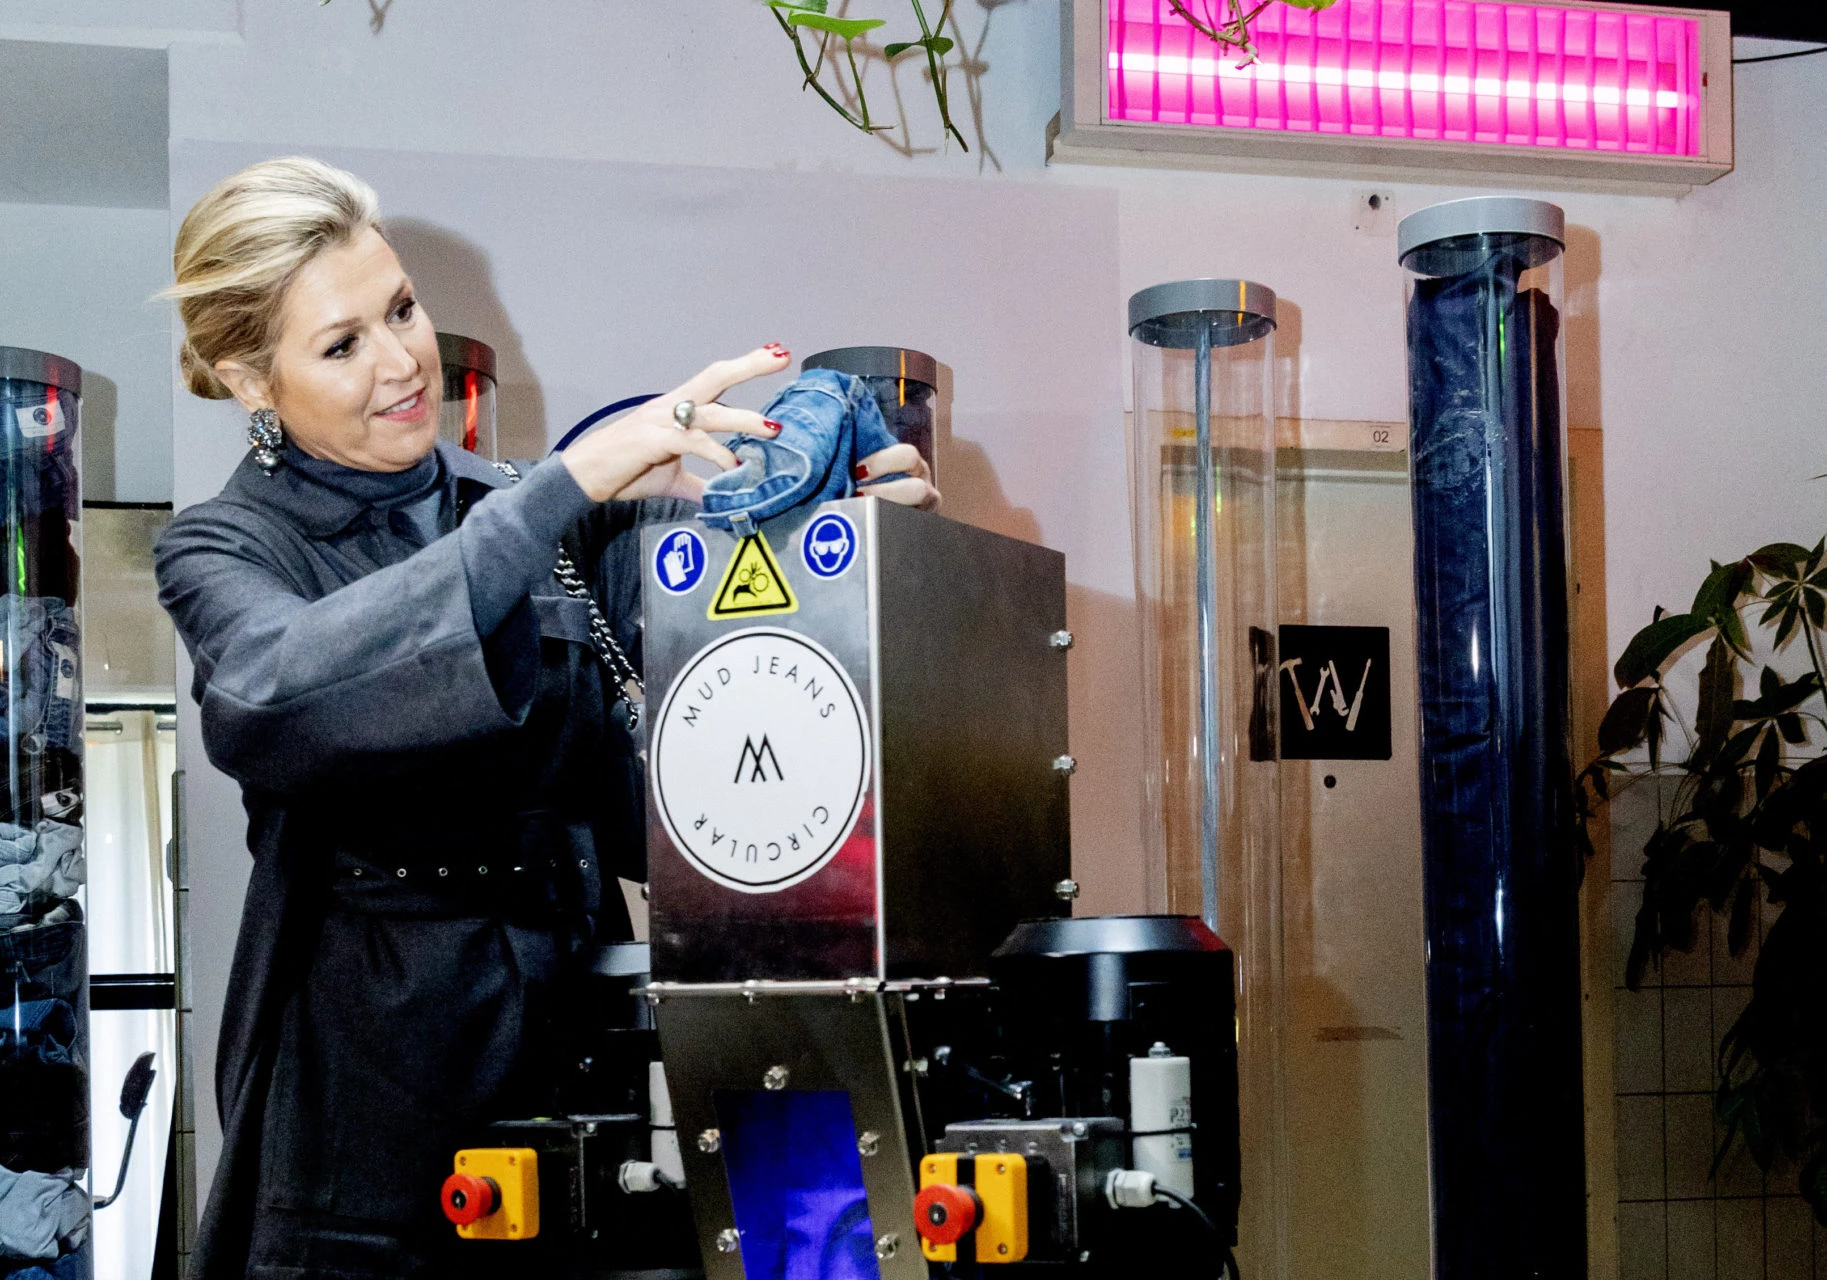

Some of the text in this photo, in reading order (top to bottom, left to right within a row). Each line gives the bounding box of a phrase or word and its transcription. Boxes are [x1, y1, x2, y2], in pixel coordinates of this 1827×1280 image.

[1373, 430, 1389, 443] 02
[682, 655, 836, 728] MUD JEANS
[694, 805, 830, 864] CIRCULAR
